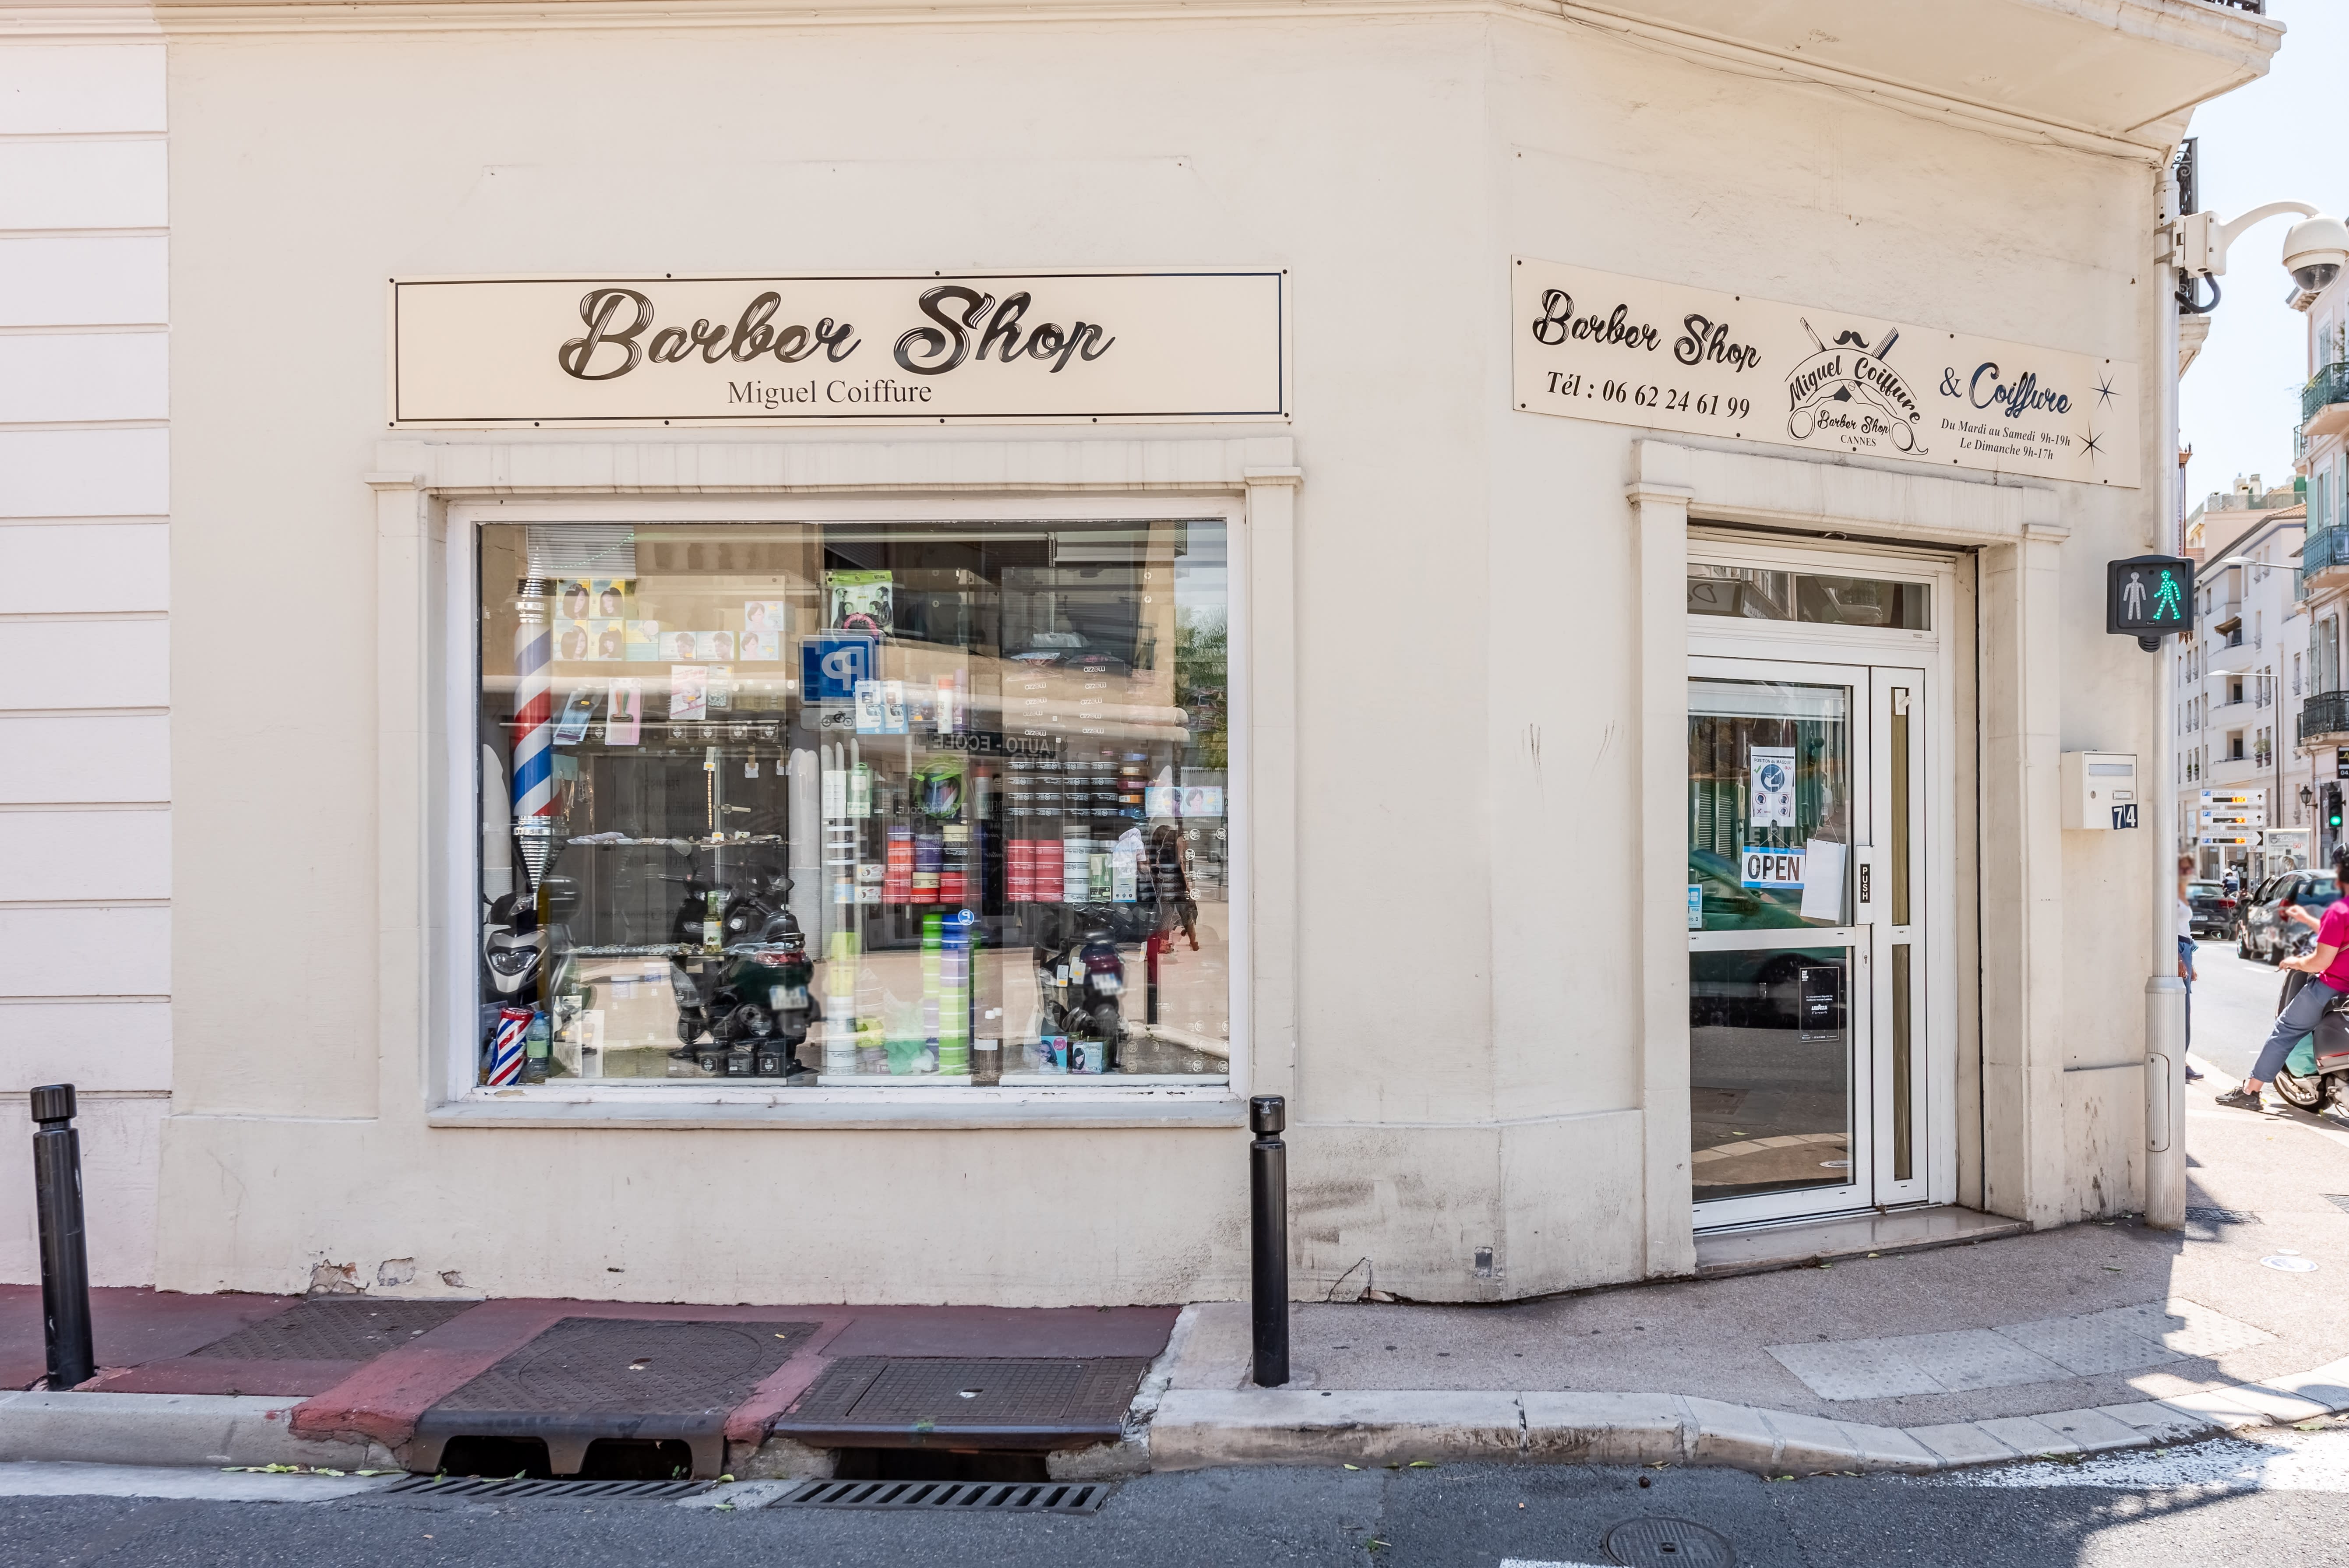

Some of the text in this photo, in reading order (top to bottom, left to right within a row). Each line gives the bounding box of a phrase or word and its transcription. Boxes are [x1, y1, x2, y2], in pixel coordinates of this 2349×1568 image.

[558, 285, 1116, 380] Barber Shop
[1532, 289, 1762, 373] Barber Shop
[728, 379, 931, 409] Miguel Coiffure
[1547, 370, 1581, 396] Tél
[1603, 380, 1627, 403] 06
[1635, 384, 1658, 407] 62
[1665, 388, 1690, 412] 24
[1697, 393, 1719, 416] 61
[1727, 397, 1750, 419] 99
[1789, 355, 1920, 424] Miguel Coiffure
[1940, 362, 2073, 419] & Coiffure
[1817, 410, 1890, 435] Barber Shop
[1941, 418, 1955, 430] Du
[1958, 420, 1987, 434] Mardi
[2003, 427, 2035, 441] Samedi
[2040, 432, 2071, 446] 9h-19h
[1841, 435, 1876, 447] CANNES
[1960, 437, 2054, 460] Le Dimanche 9h-17h
[2114, 806, 2136, 829] 74
[1747, 854, 1800, 881] OPEN
